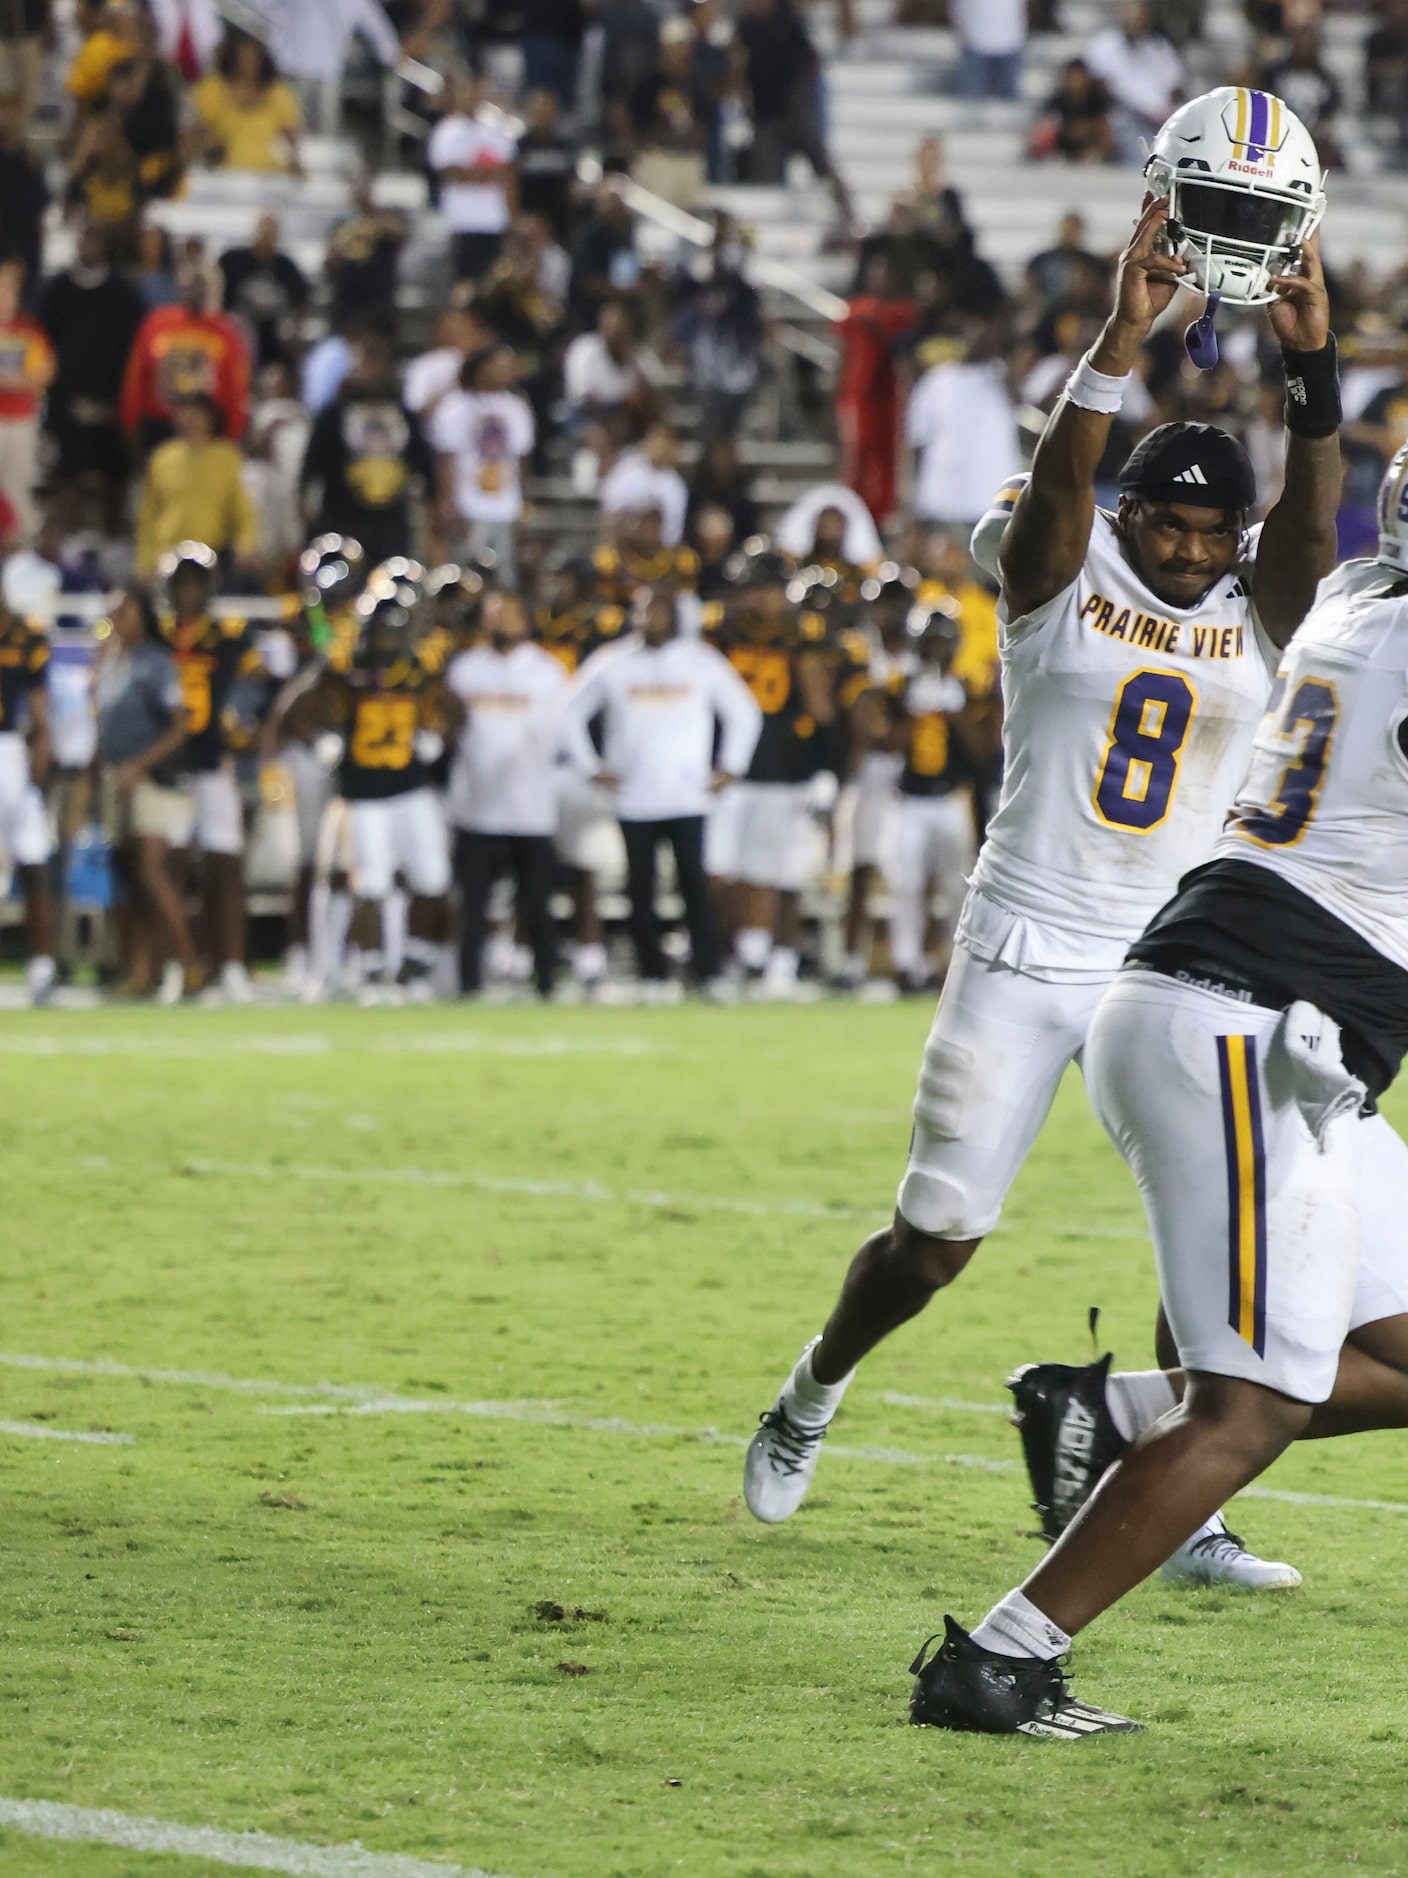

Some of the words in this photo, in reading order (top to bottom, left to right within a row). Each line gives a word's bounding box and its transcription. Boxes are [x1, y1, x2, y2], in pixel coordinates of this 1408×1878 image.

[1228, 160, 1274, 178] Riddell
[1078, 592, 1181, 655] PRAIRIE
[1091, 666, 1200, 836] 8
[1233, 669, 1341, 850] 3
